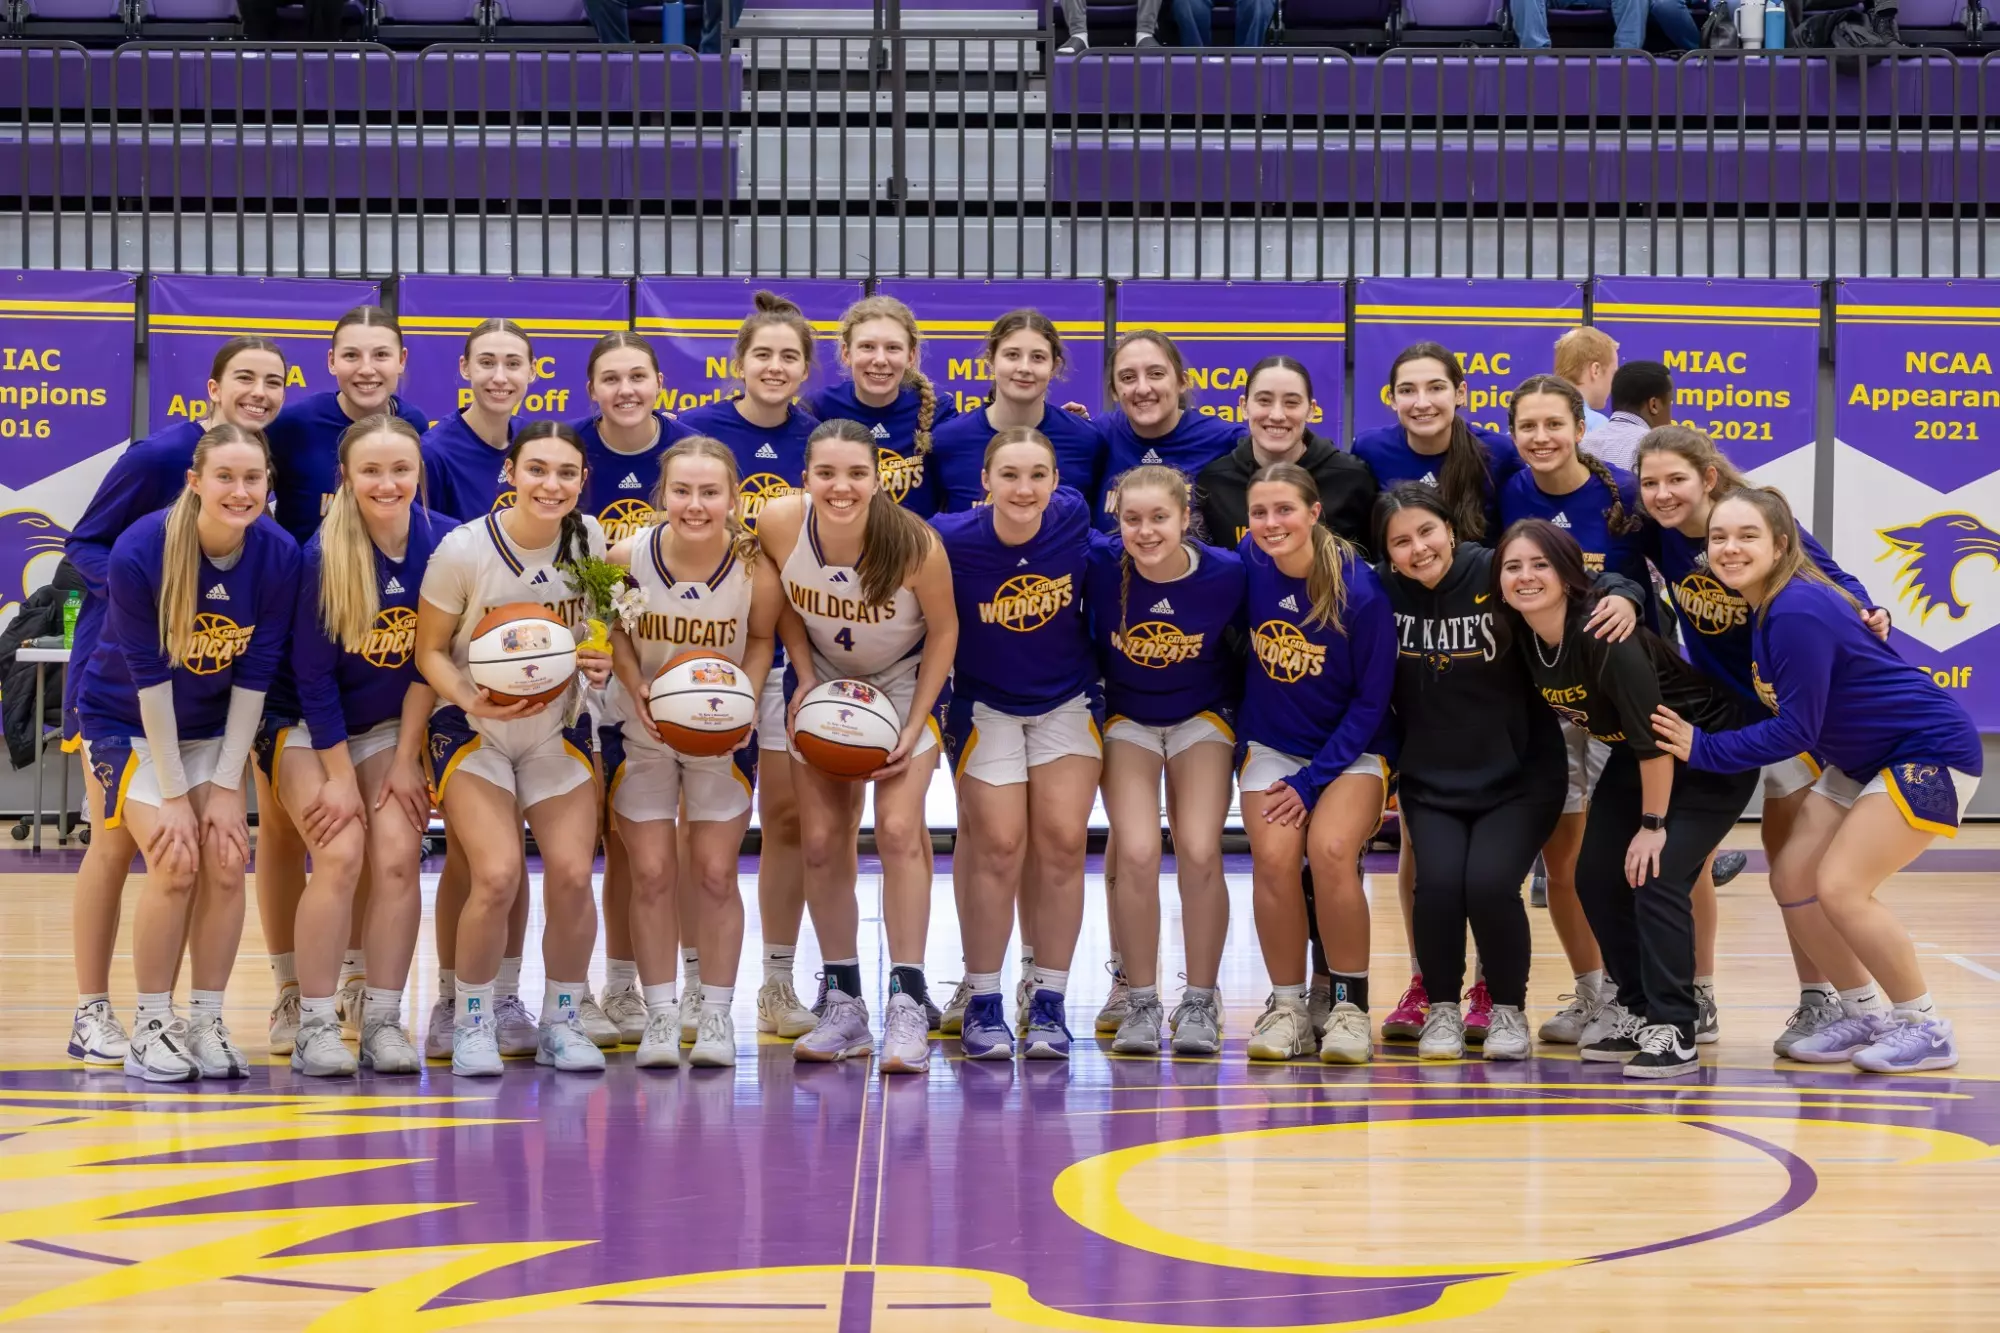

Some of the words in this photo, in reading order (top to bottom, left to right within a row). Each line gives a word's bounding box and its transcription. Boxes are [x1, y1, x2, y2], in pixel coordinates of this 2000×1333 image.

[948, 358, 996, 380] MI
[1454, 352, 1511, 375] IAC
[1663, 350, 1747, 374] MIAC
[1905, 351, 1993, 374] NCAA
[1187, 367, 1248, 390] NCA
[0, 381, 107, 410] mpions
[652, 387, 741, 410] Worl
[1671, 383, 1791, 411] mpions
[1848, 383, 2000, 411] Appearan
[0, 418, 51, 438] 016
[1914, 421, 1979, 440] 2021
[880, 465, 924, 492] CATS
[979, 583, 1073, 624] WILDCATS
[1149, 606, 1175, 615] adidas
[1671, 581, 1749, 625] WILDCATS
[637, 611, 737, 647] WILDCATS
[834, 626, 856, 652] 4
[1393, 612, 1416, 660] T.
[1423, 612, 1497, 662] KATE'S
[1250, 627, 1326, 676] WILDCATS
[1916, 666, 1973, 688] olf
[1542, 684, 1588, 704] KATE'S
